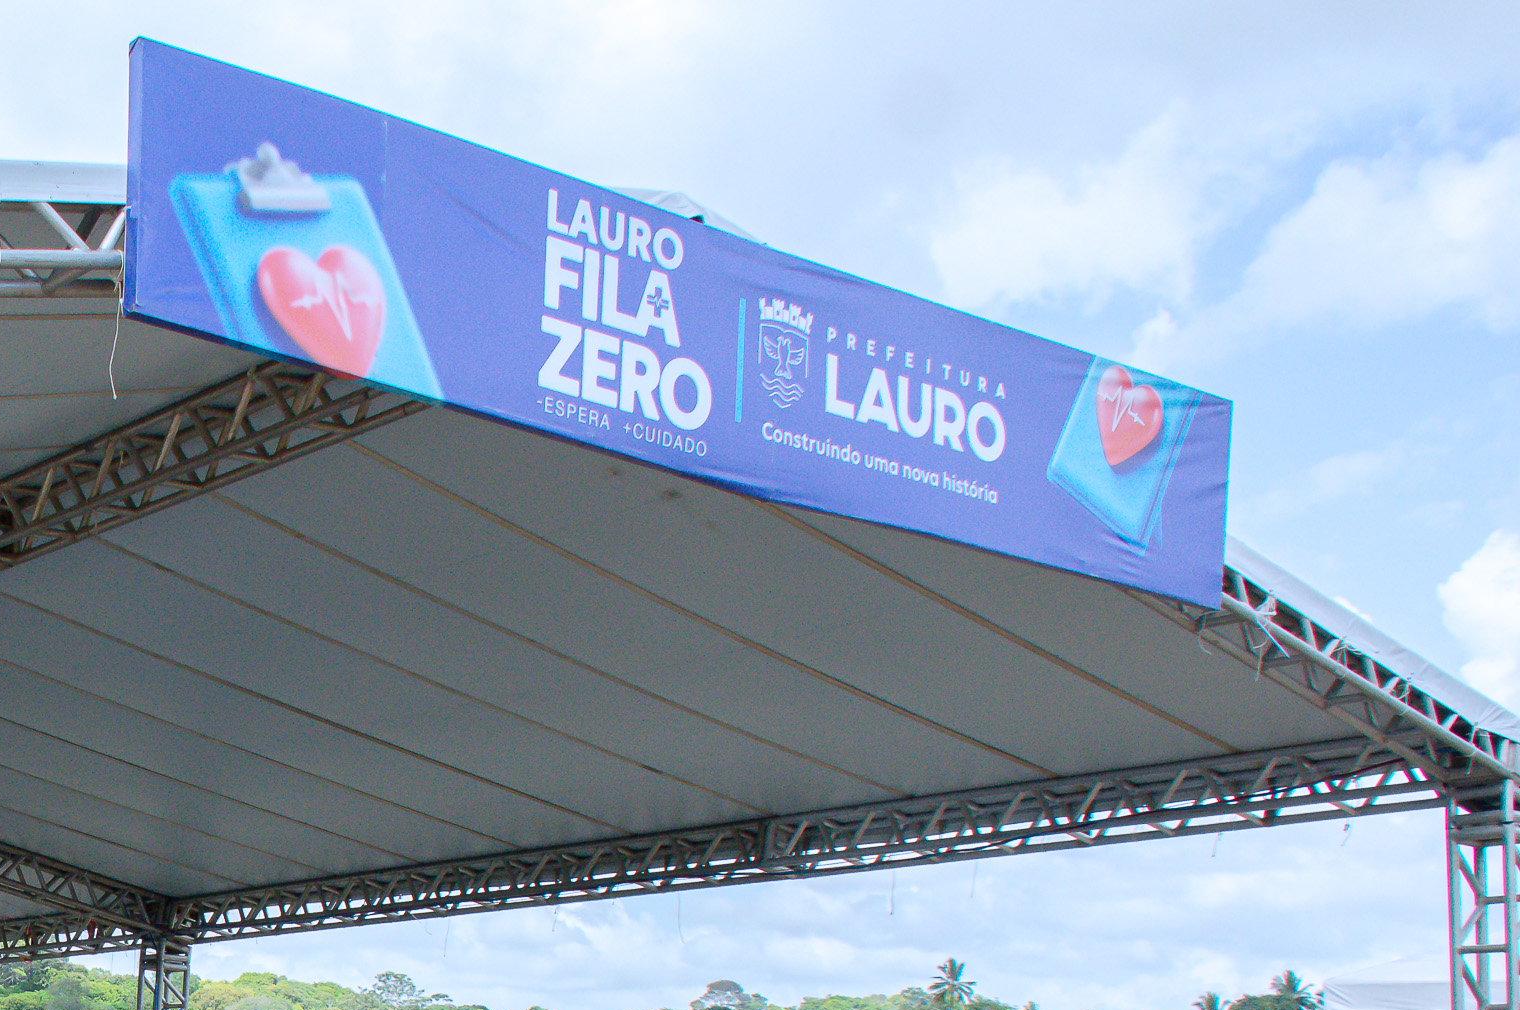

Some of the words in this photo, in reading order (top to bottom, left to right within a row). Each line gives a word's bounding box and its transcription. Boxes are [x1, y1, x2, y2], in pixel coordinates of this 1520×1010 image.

[547, 188, 684, 270] LAURO
[544, 236, 681, 348] FILA
[538, 315, 713, 431] ZERO
[826, 327, 1007, 400] PREFEITURA
[536, 396, 611, 431] -ESPERA
[622, 422, 708, 457] +CUIDADO
[825, 353, 1007, 463] LAURO
[762, 422, 862, 465] Construindo
[863, 453, 900, 476] uma
[902, 464, 940, 487] nova
[942, 471, 999, 504] história
